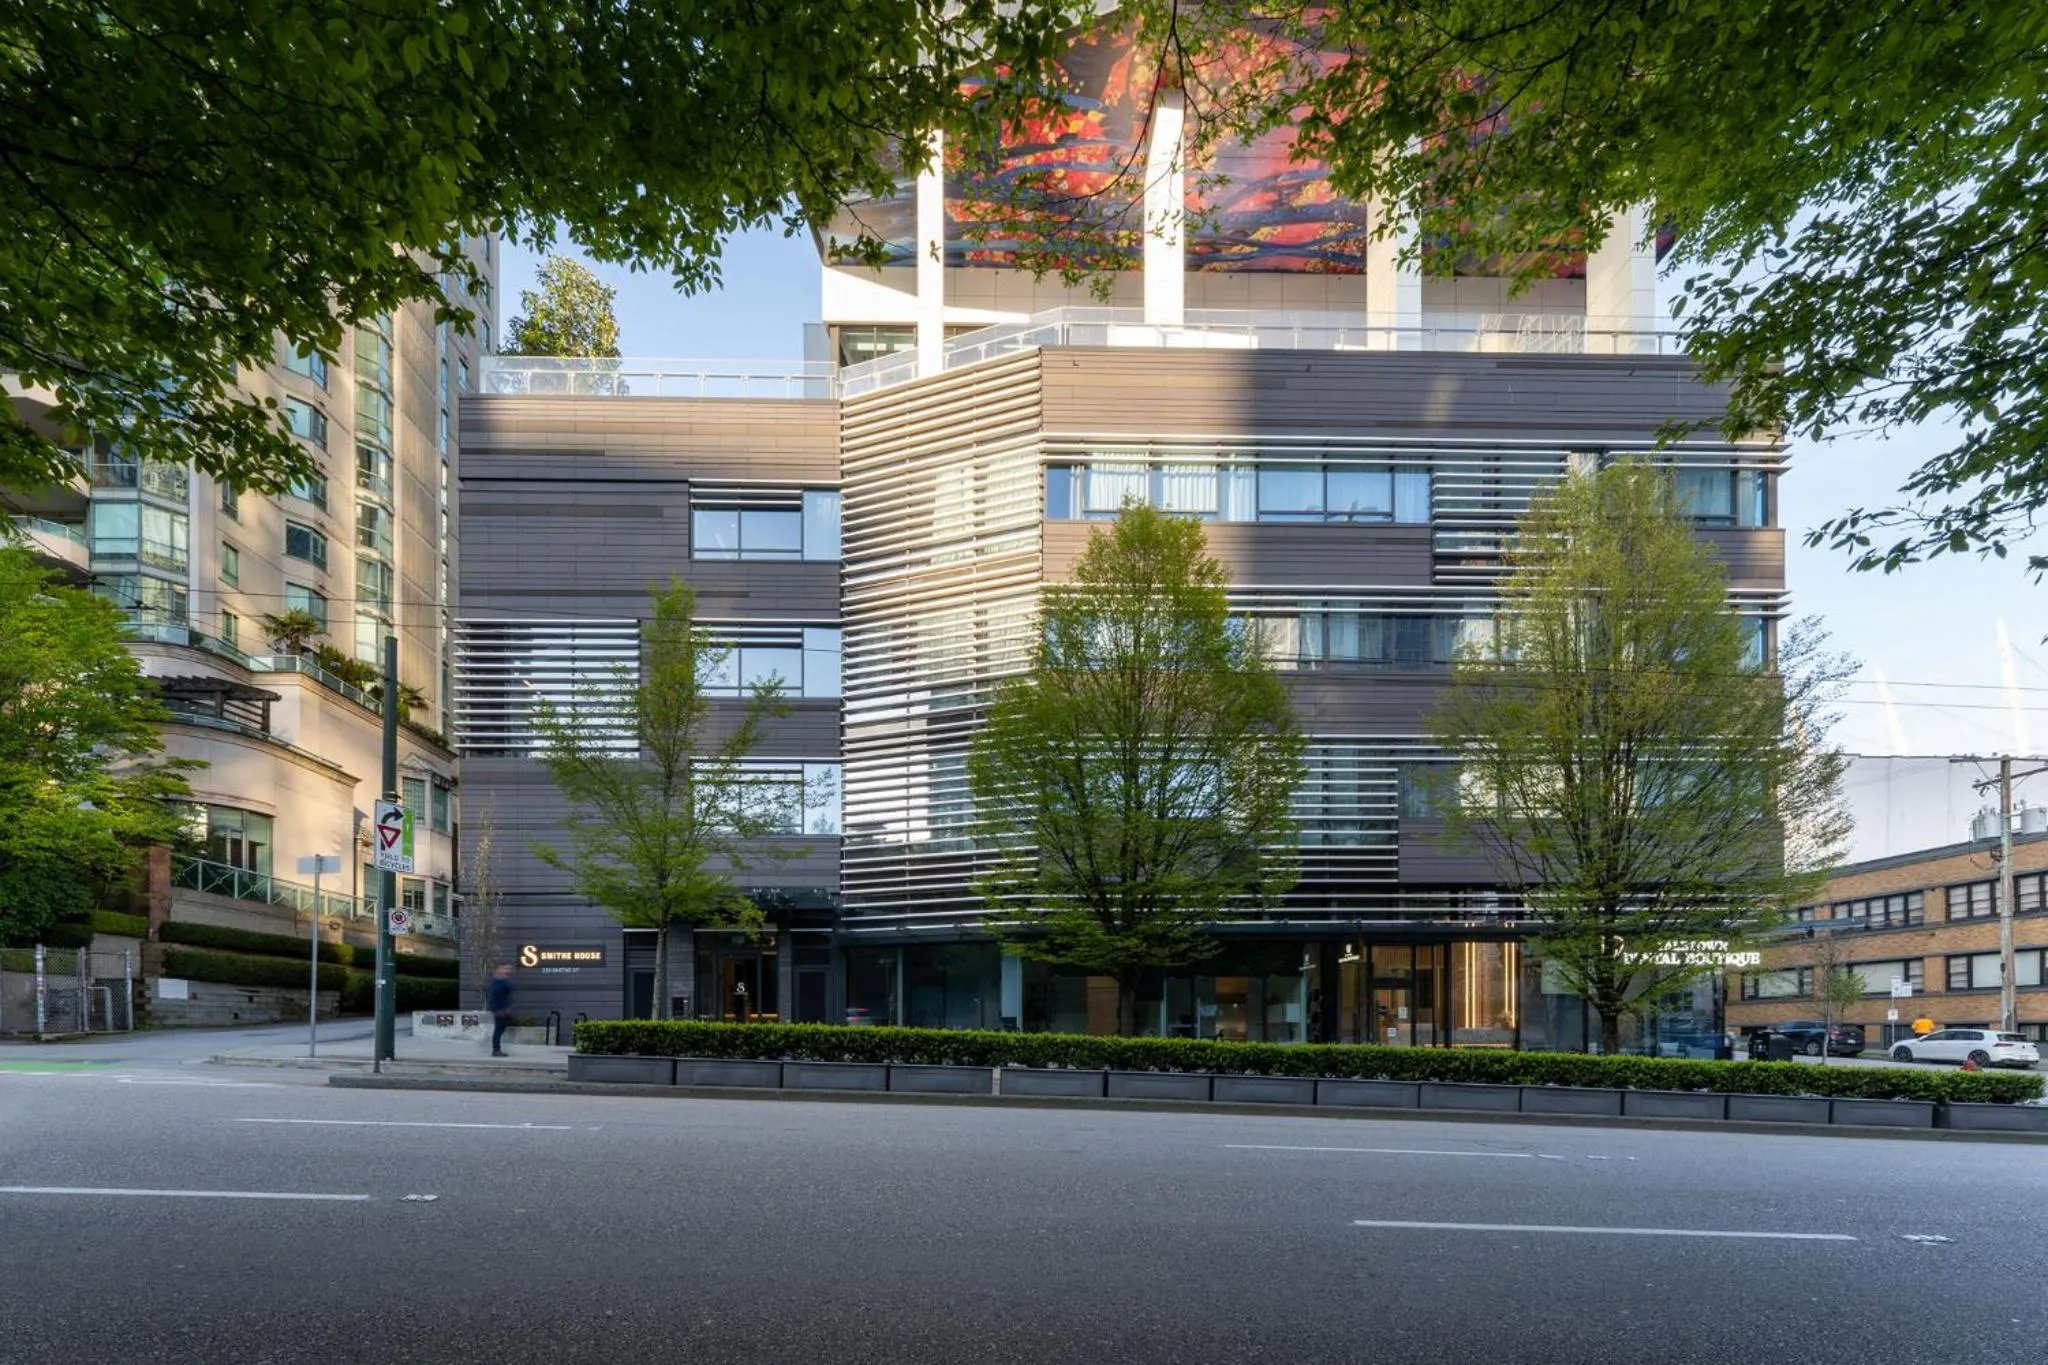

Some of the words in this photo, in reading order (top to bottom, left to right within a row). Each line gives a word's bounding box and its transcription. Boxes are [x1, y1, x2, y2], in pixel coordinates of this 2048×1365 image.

[521, 945, 538, 967] S
[541, 951, 571, 960] SMITHE
[574, 951, 601, 960] HOUSE
